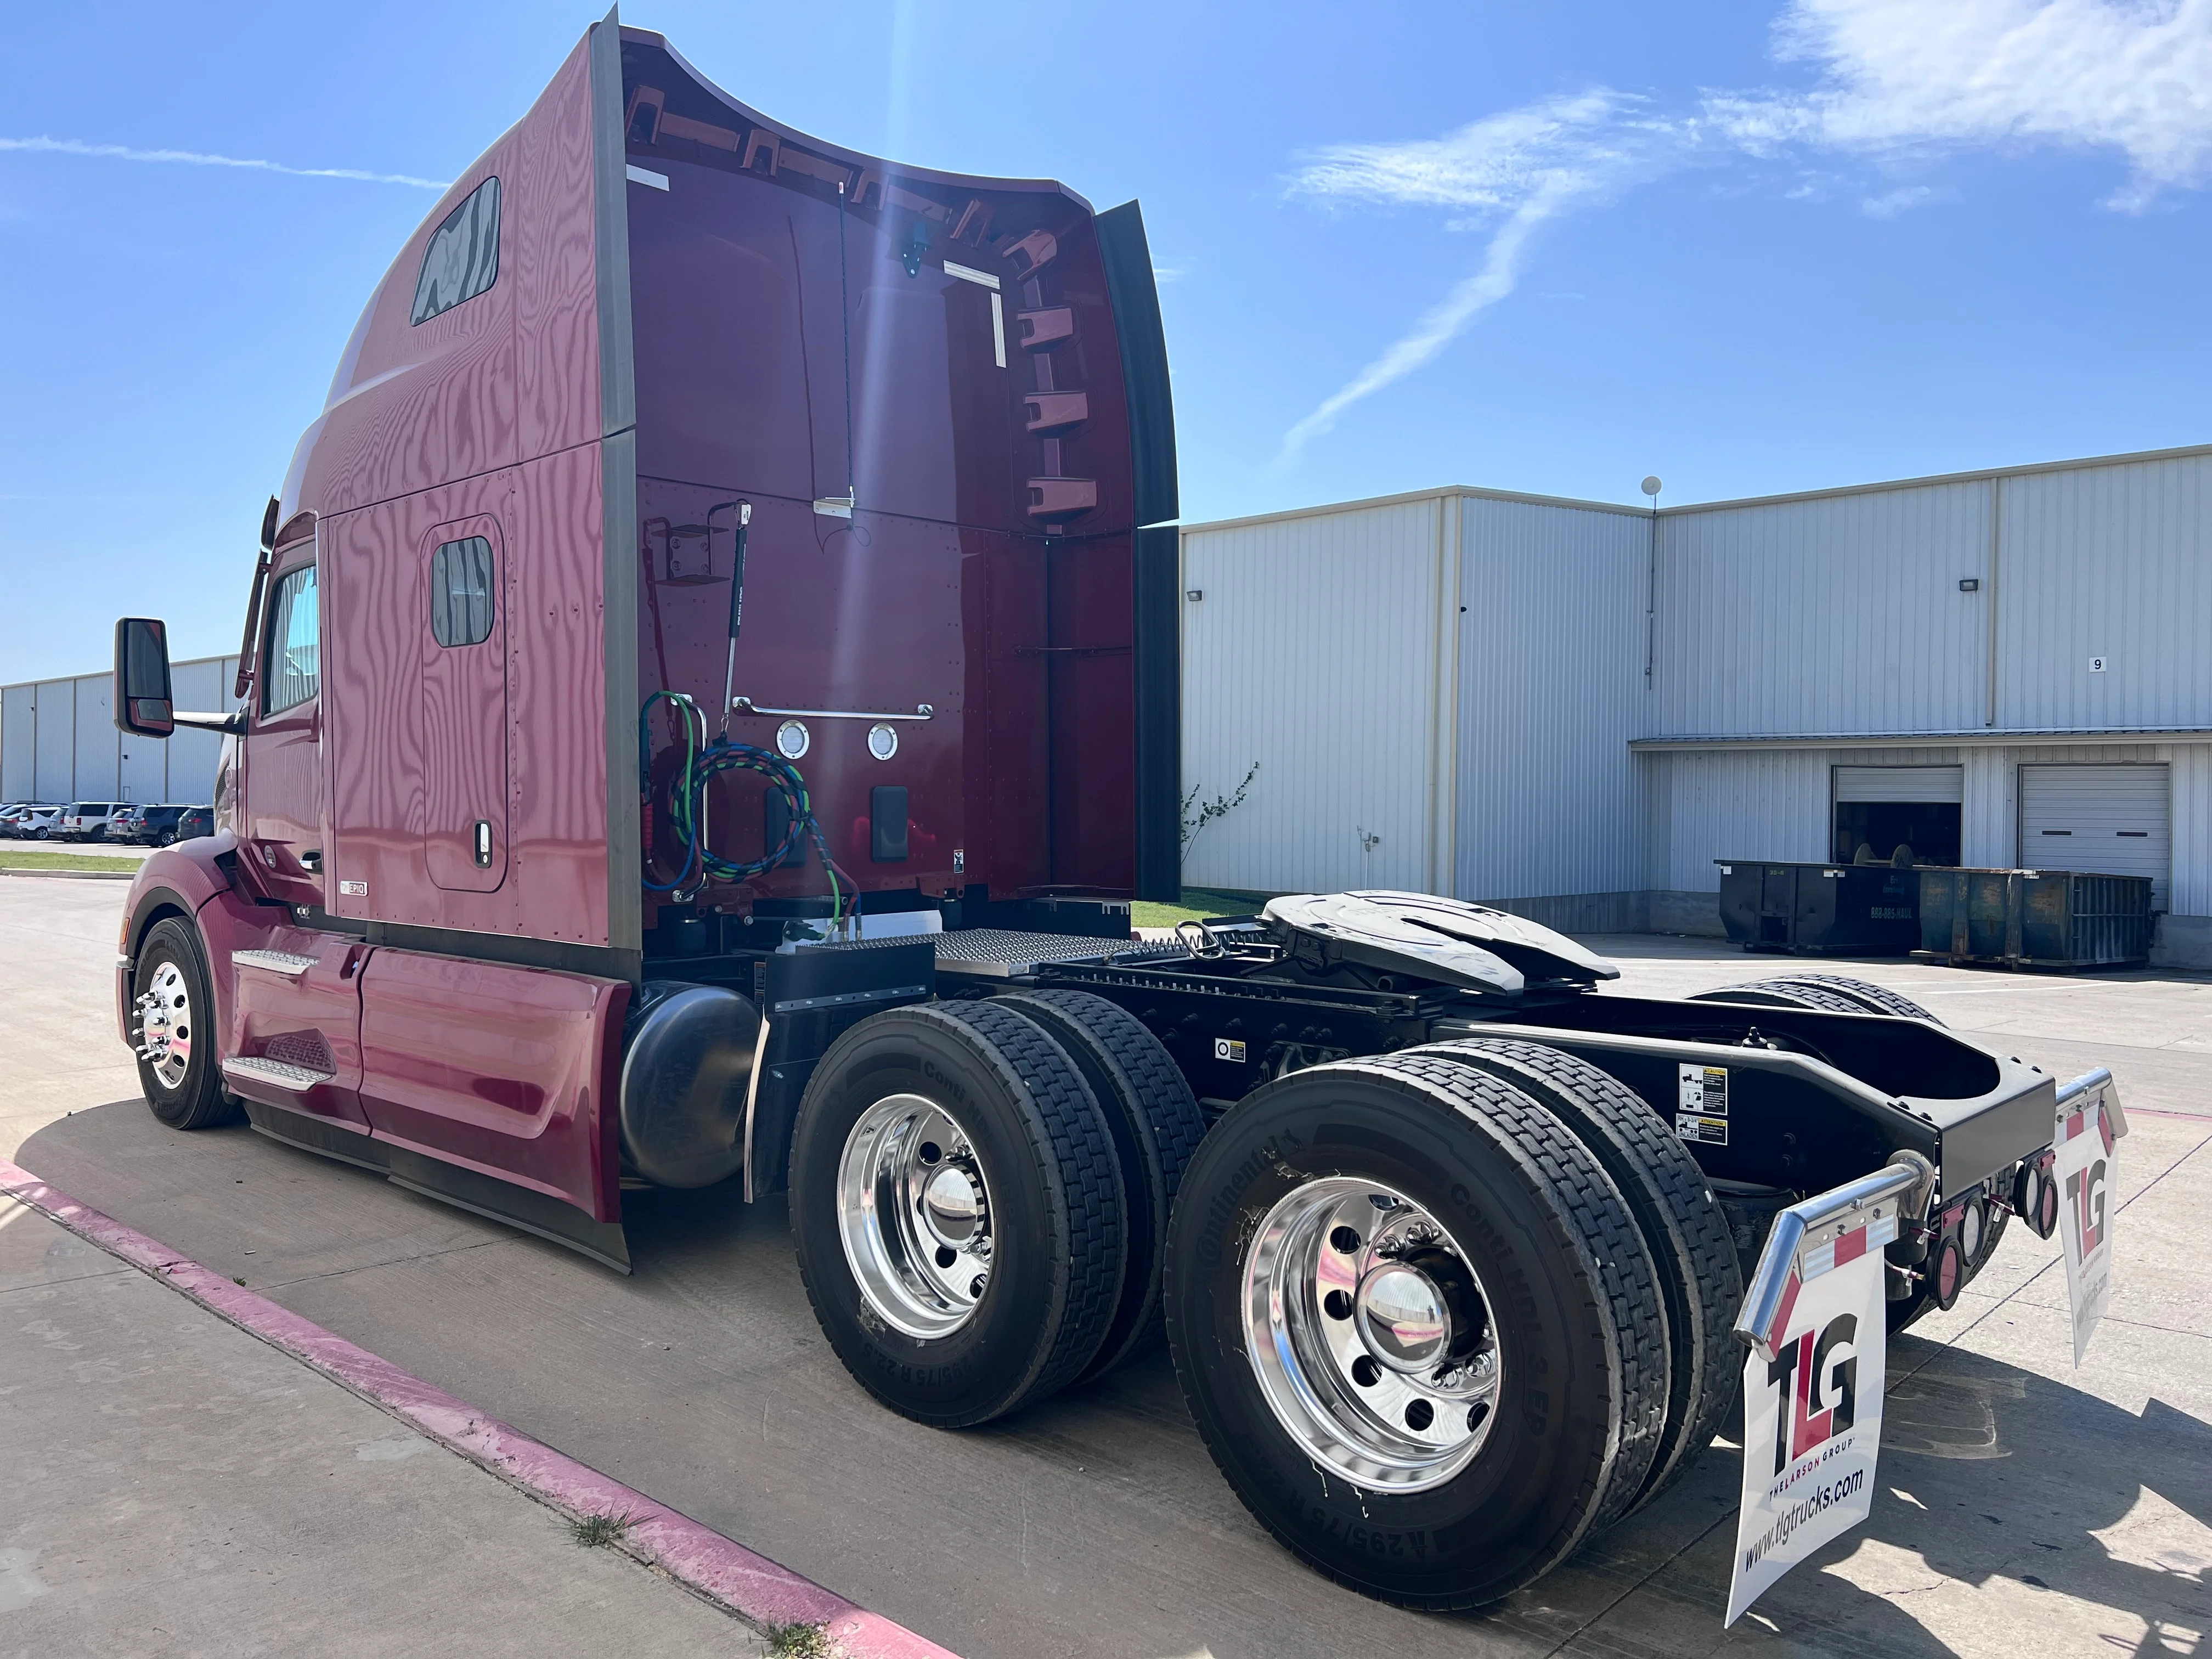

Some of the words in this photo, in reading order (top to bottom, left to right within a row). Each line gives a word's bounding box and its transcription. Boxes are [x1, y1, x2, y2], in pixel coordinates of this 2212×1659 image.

[2095, 659, 2101, 669] 9
[350, 884, 364, 894] EPIQ
[924, 1060, 966, 1104] Conti
[1196, 1135, 1285, 1267] Continental
[2066, 1159, 2106, 1267] TLG
[1451, 1183, 1514, 1263] Conti
[1505, 1268, 1542, 1339] HDL
[1527, 1388, 1550, 1437] EP
[1768, 1313, 1858, 1477] TLG
[1822, 1438, 1852, 1462] GROUP
[1745, 1468, 1864, 1572] www.tlgtrucks.com
